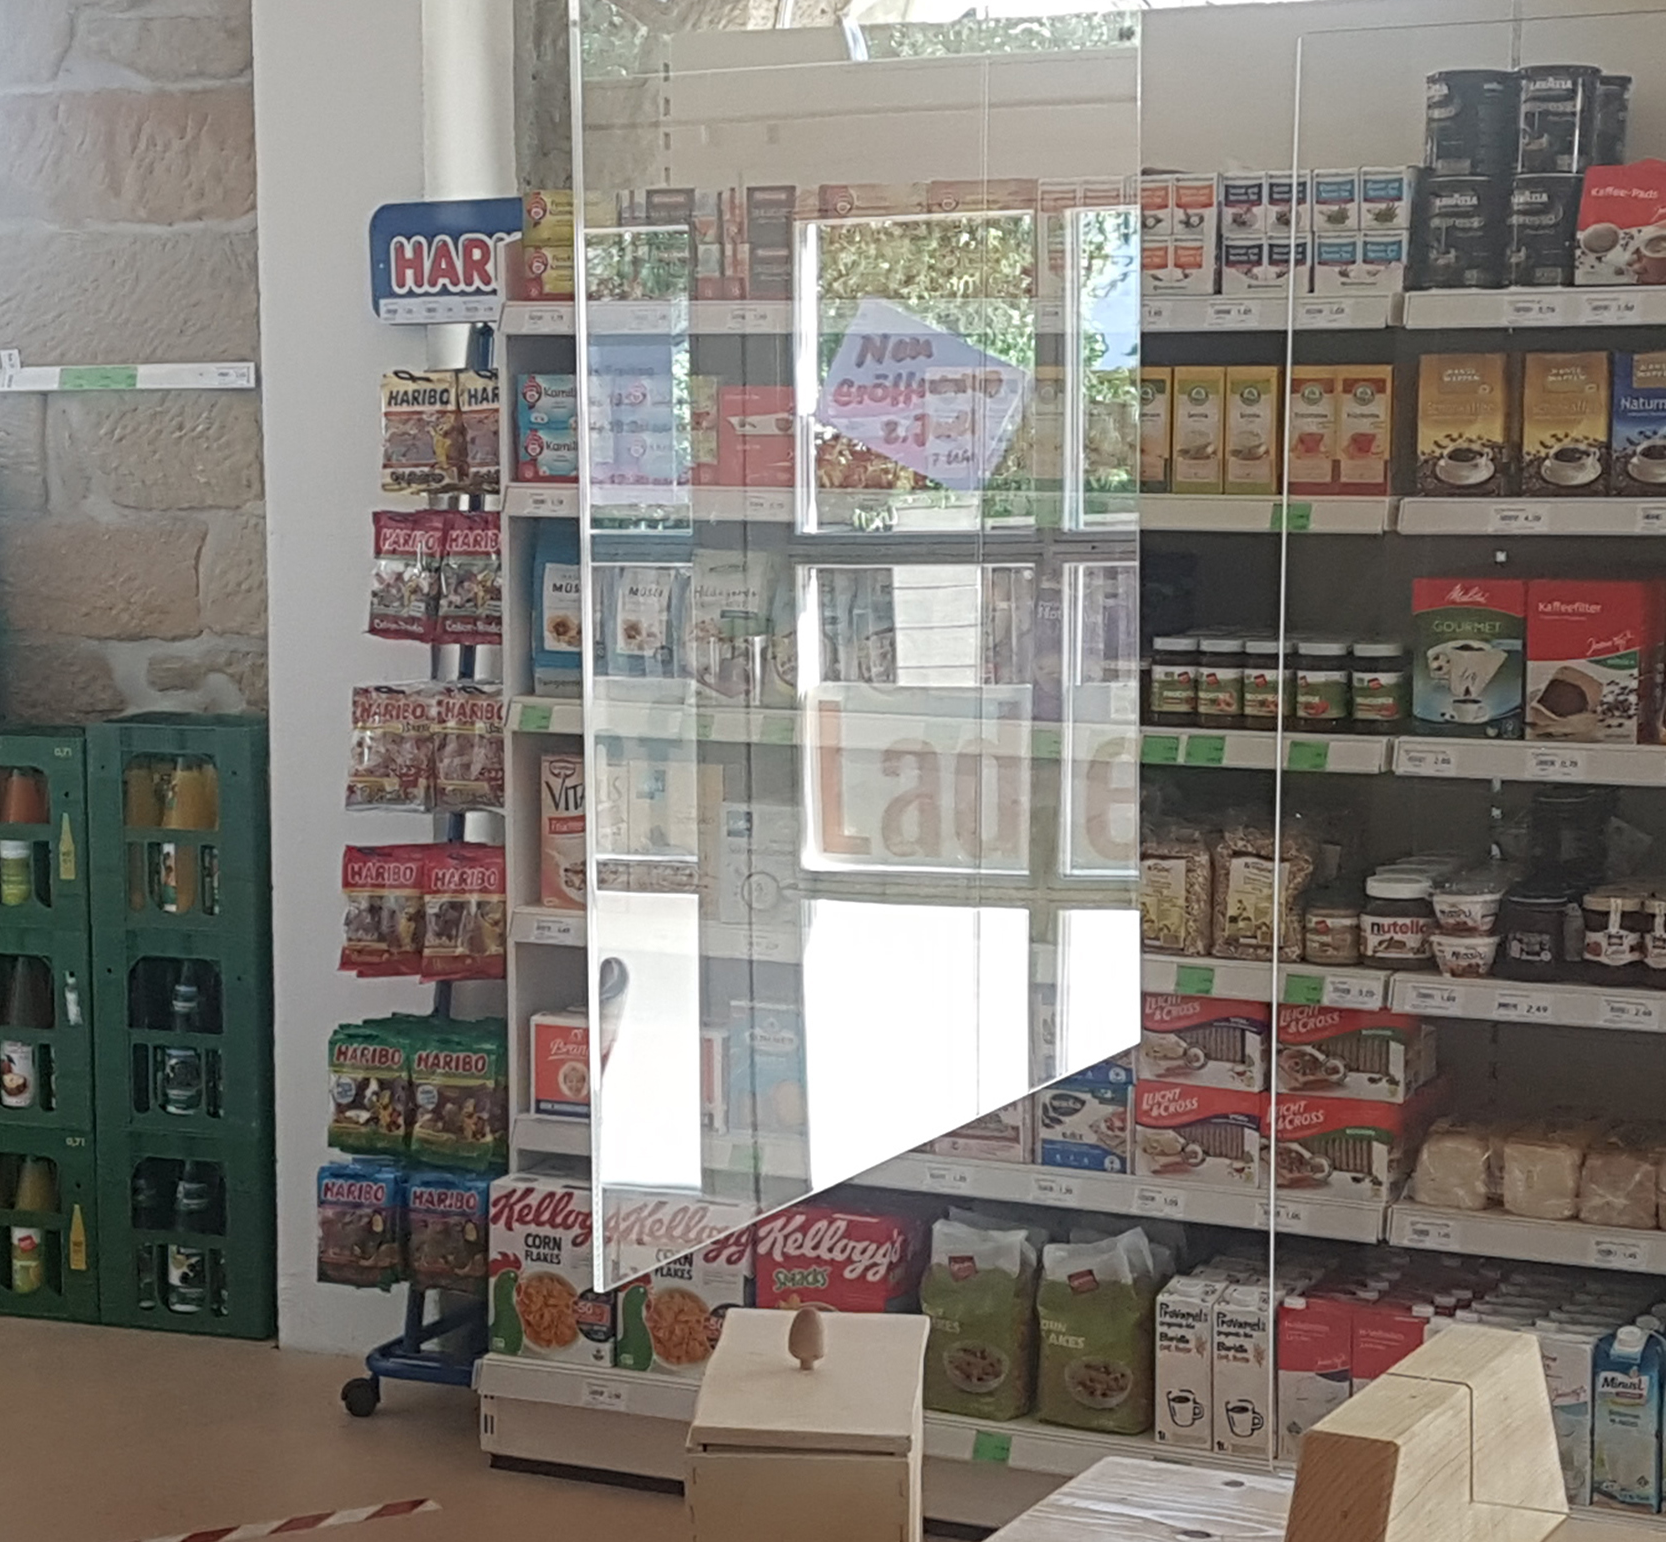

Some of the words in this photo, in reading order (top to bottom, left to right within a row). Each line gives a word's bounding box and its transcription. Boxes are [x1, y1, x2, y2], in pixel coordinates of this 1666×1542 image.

[386, 386, 451, 407] HARIBO
[1538, 602, 1603, 615] Kaffeefilter
[1434, 620, 1503, 634] GOURMET
[357, 700, 427, 722] HARIBO
[347, 861, 416, 884] HARIBO
[433, 867, 498, 890] HARIBO
[1153, 1001, 1201, 1022] &CROSS
[1287, 1010, 1340, 1035] &CROSS
[335, 1043, 403, 1067] HARIBO
[416, 1051, 488, 1074] HARIBO
[1141, 1088, 1181, 1112] LEICHT
[1150, 1097, 1199, 1118] &CROSS
[322, 1179, 386, 1202] HARIBO
[412, 1187, 478, 1212] HARIBO
[524, 1233, 563, 1252] CORN
[757, 1214, 904, 1282] Kellogg's
[524, 1250, 562, 1266] FLAKES
[655, 1247, 694, 1269] CORN
[654, 1265, 693, 1282] FLAKES
